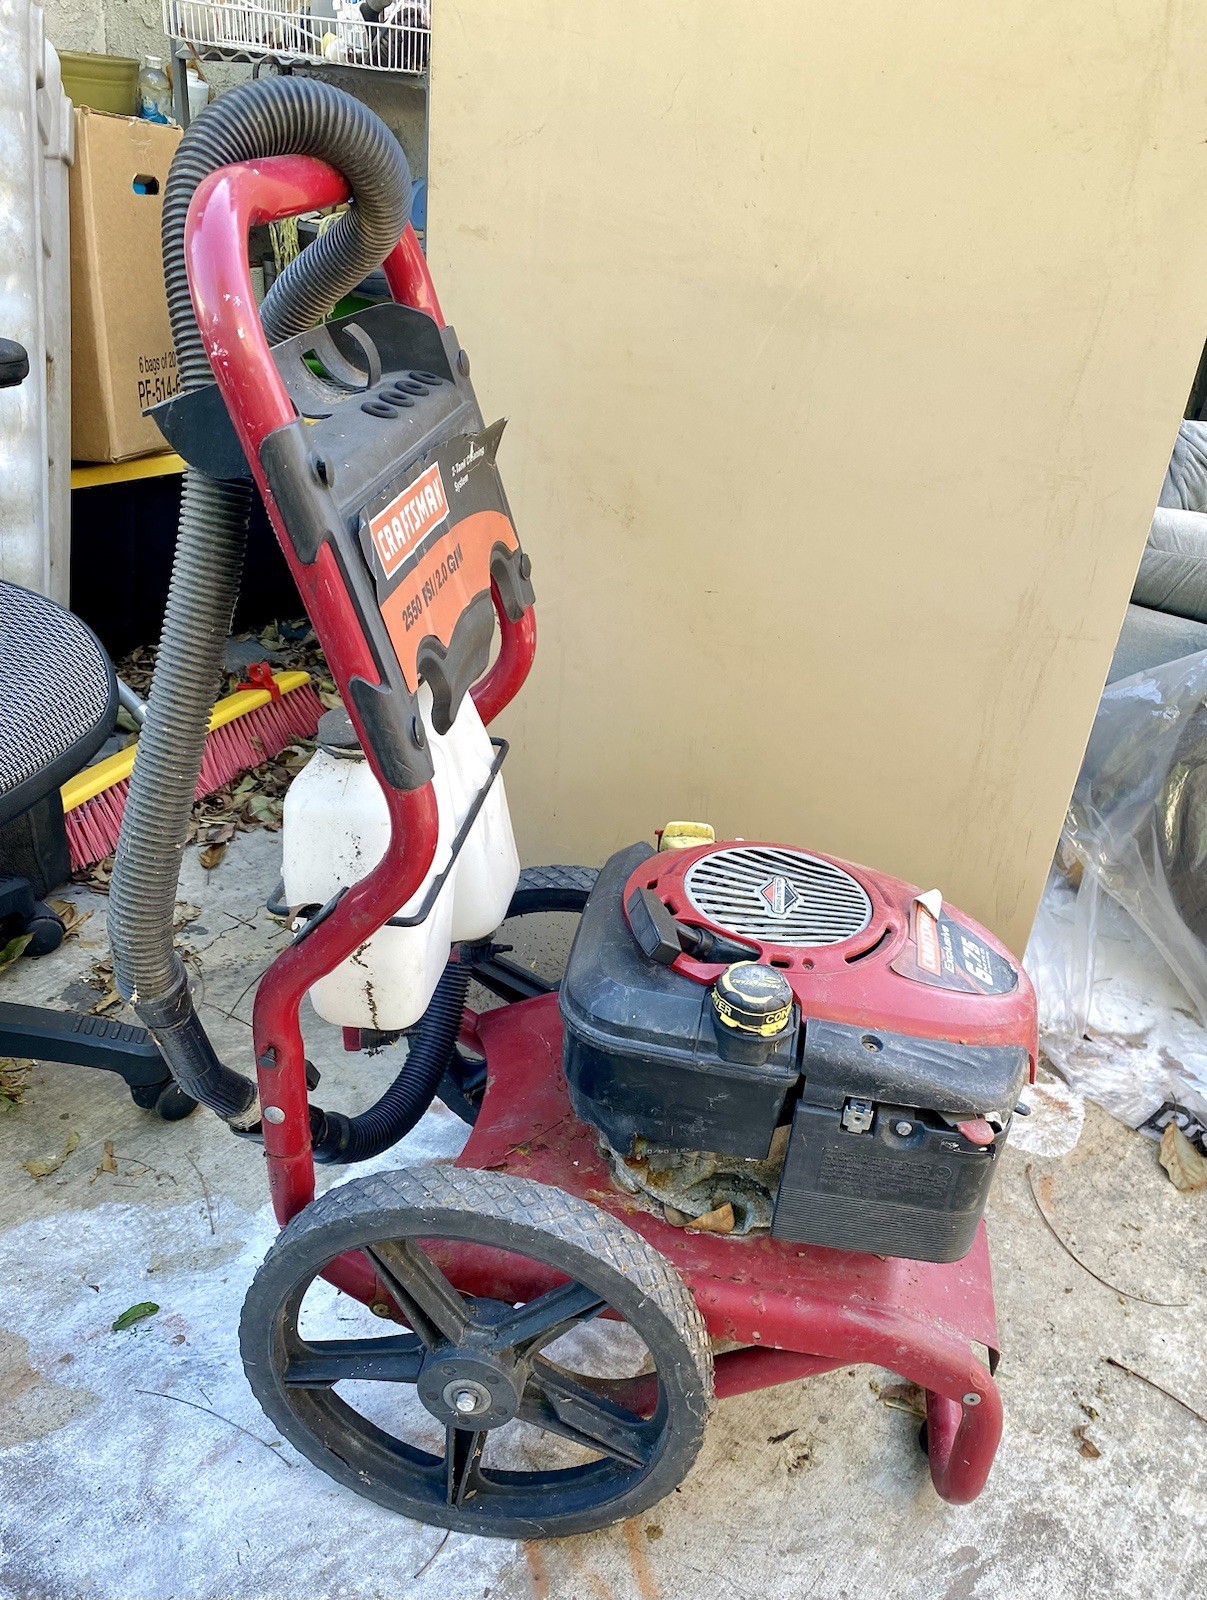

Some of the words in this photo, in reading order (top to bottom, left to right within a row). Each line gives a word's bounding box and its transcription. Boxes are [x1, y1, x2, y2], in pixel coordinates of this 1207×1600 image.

[138, 356, 144, 373] 6
[144, 354, 161, 375] bags
[161, 352, 168, 369] of
[377, 478, 444, 562] CRAFTSMAN
[402, 594, 423, 632] 2550
[941, 924, 955, 974] Exclusive
[960, 936, 994, 986] 6.75
